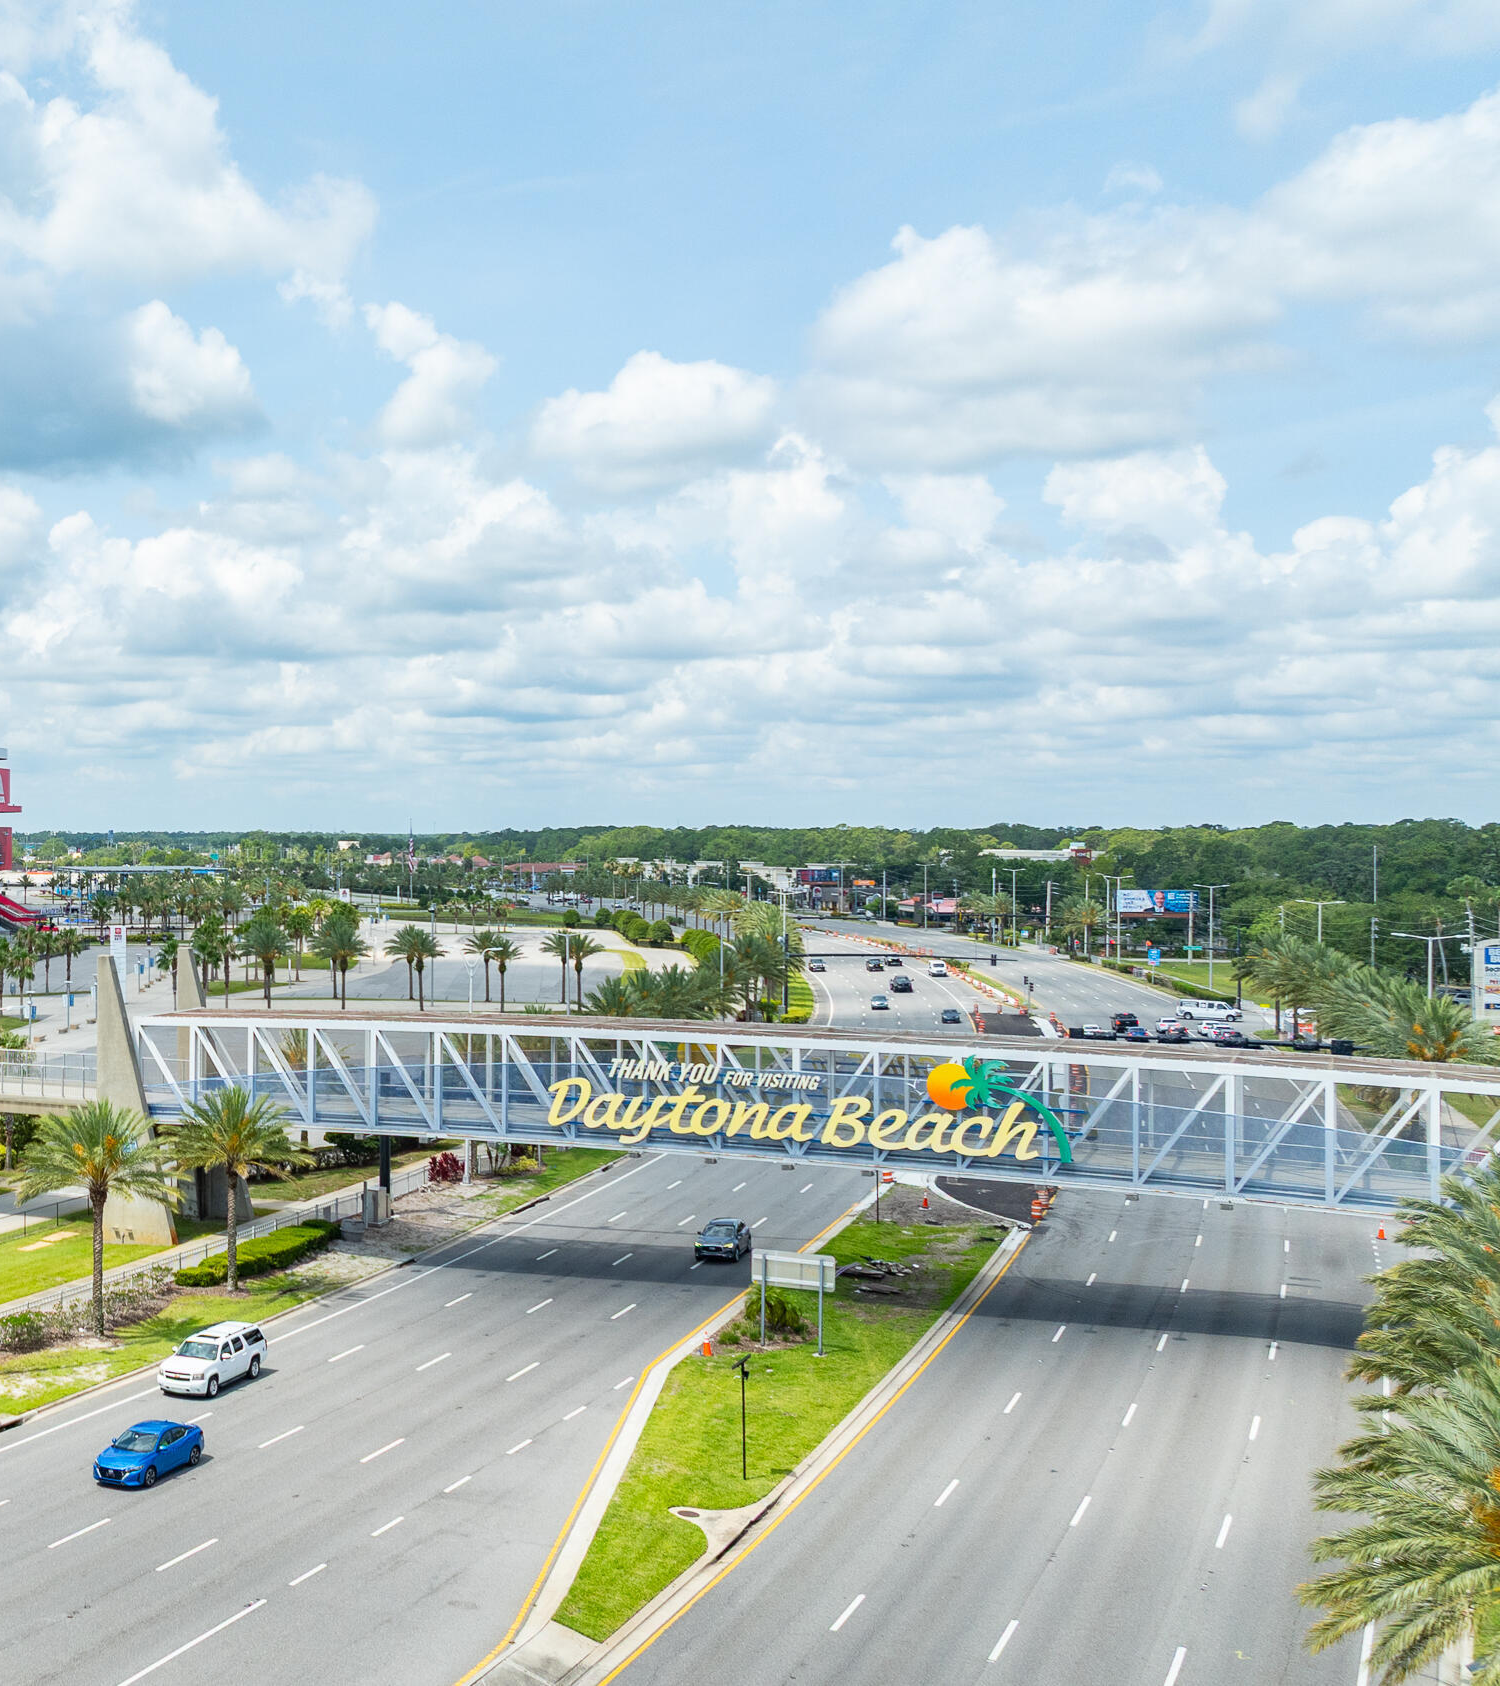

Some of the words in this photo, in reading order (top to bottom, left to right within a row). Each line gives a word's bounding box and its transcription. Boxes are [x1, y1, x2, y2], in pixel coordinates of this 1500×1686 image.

[609, 1057, 674, 1083] THANK
[675, 1062, 720, 1085] YOU
[723, 1071, 753, 1087] FOR
[757, 1073, 821, 1091] VISITING
[547, 1077, 814, 1144] Daytona
[820, 1097, 1041, 1161] Beach
